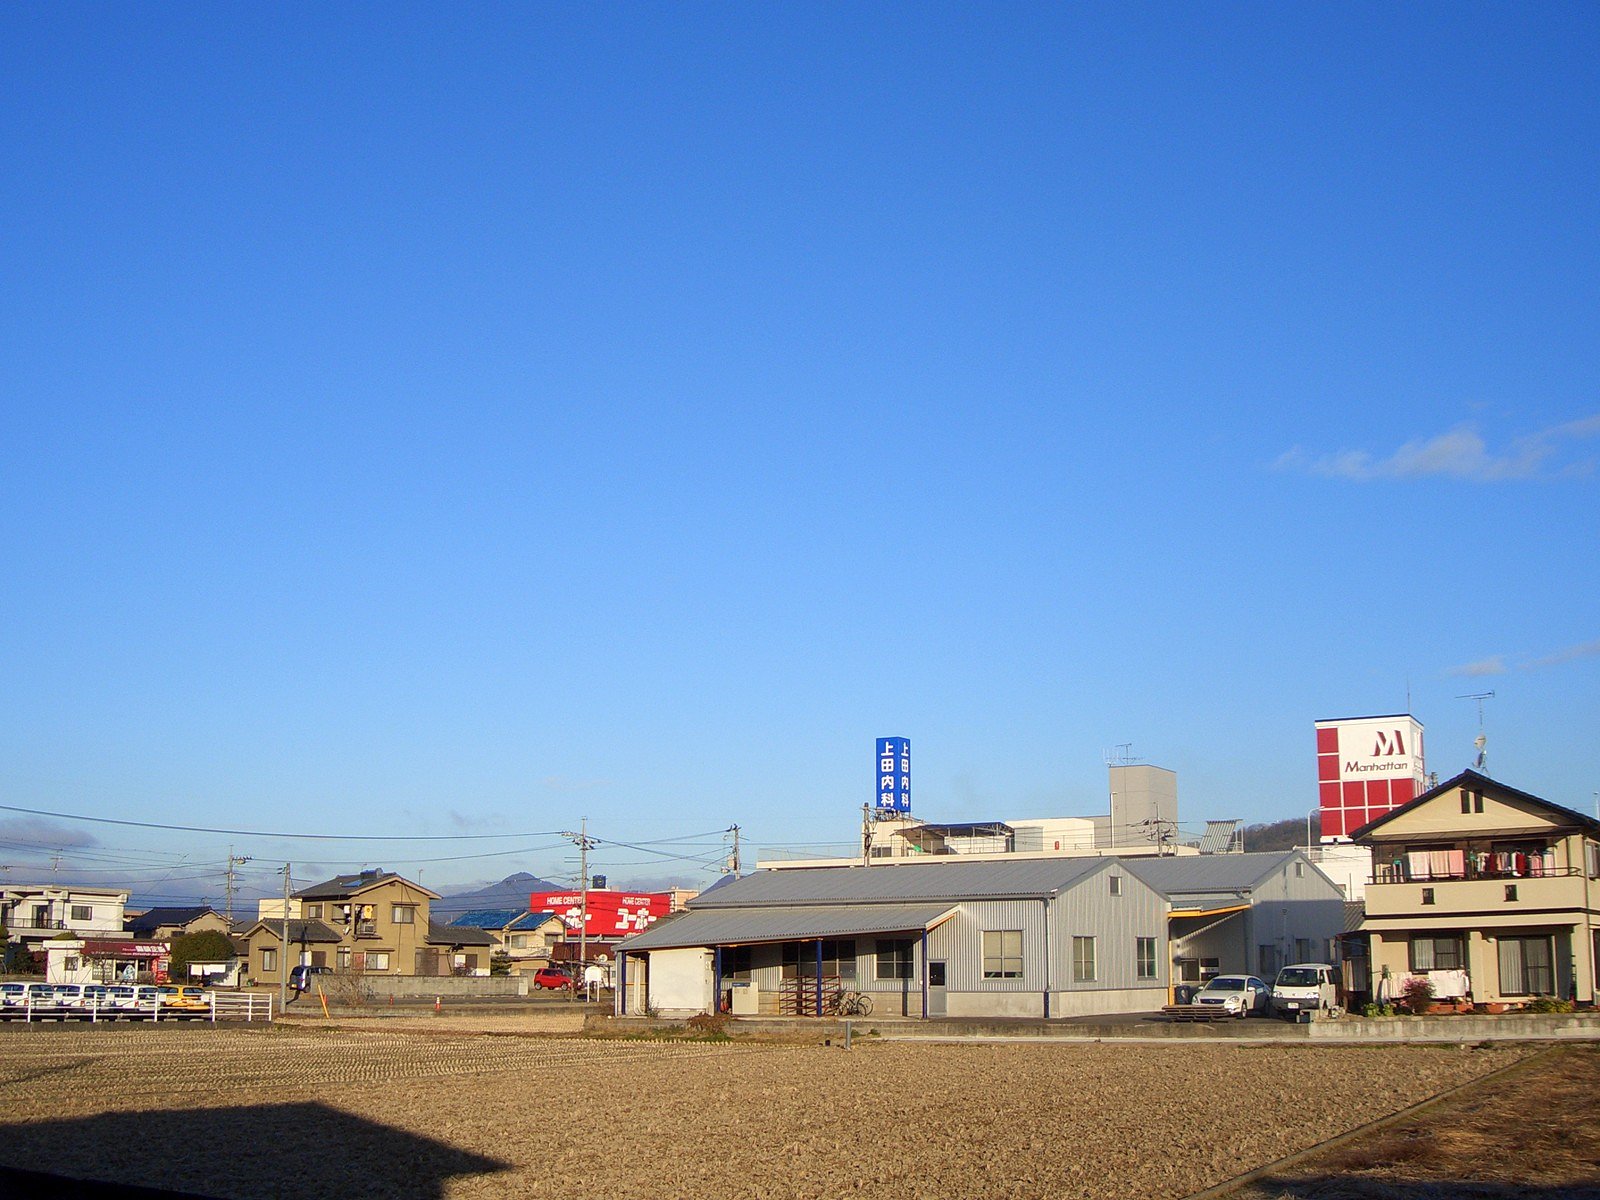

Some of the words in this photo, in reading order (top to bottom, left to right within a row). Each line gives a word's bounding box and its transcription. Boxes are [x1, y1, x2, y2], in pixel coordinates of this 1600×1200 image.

[881, 742, 894, 807] 上田内科
[901, 742, 909, 807] 上田内科
[1345, 761, 1407, 773] Manhattan
[622, 897, 634, 905] HOME
[635, 897, 651, 905] CENTER
